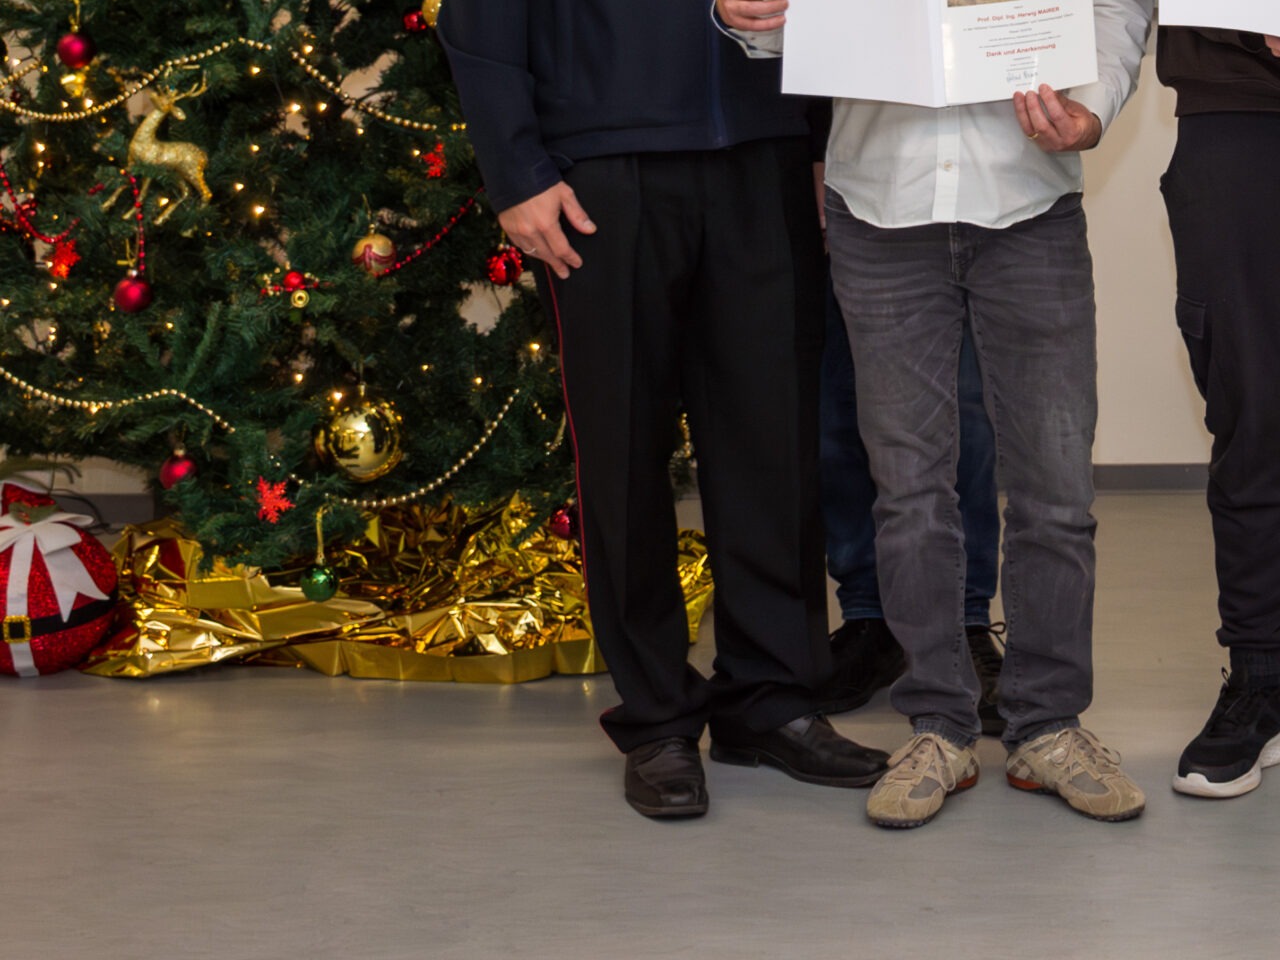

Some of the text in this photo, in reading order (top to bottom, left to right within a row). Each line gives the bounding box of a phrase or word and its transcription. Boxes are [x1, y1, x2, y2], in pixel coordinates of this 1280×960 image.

[986, 43, 1056, 58] Dank und Anerkennung
